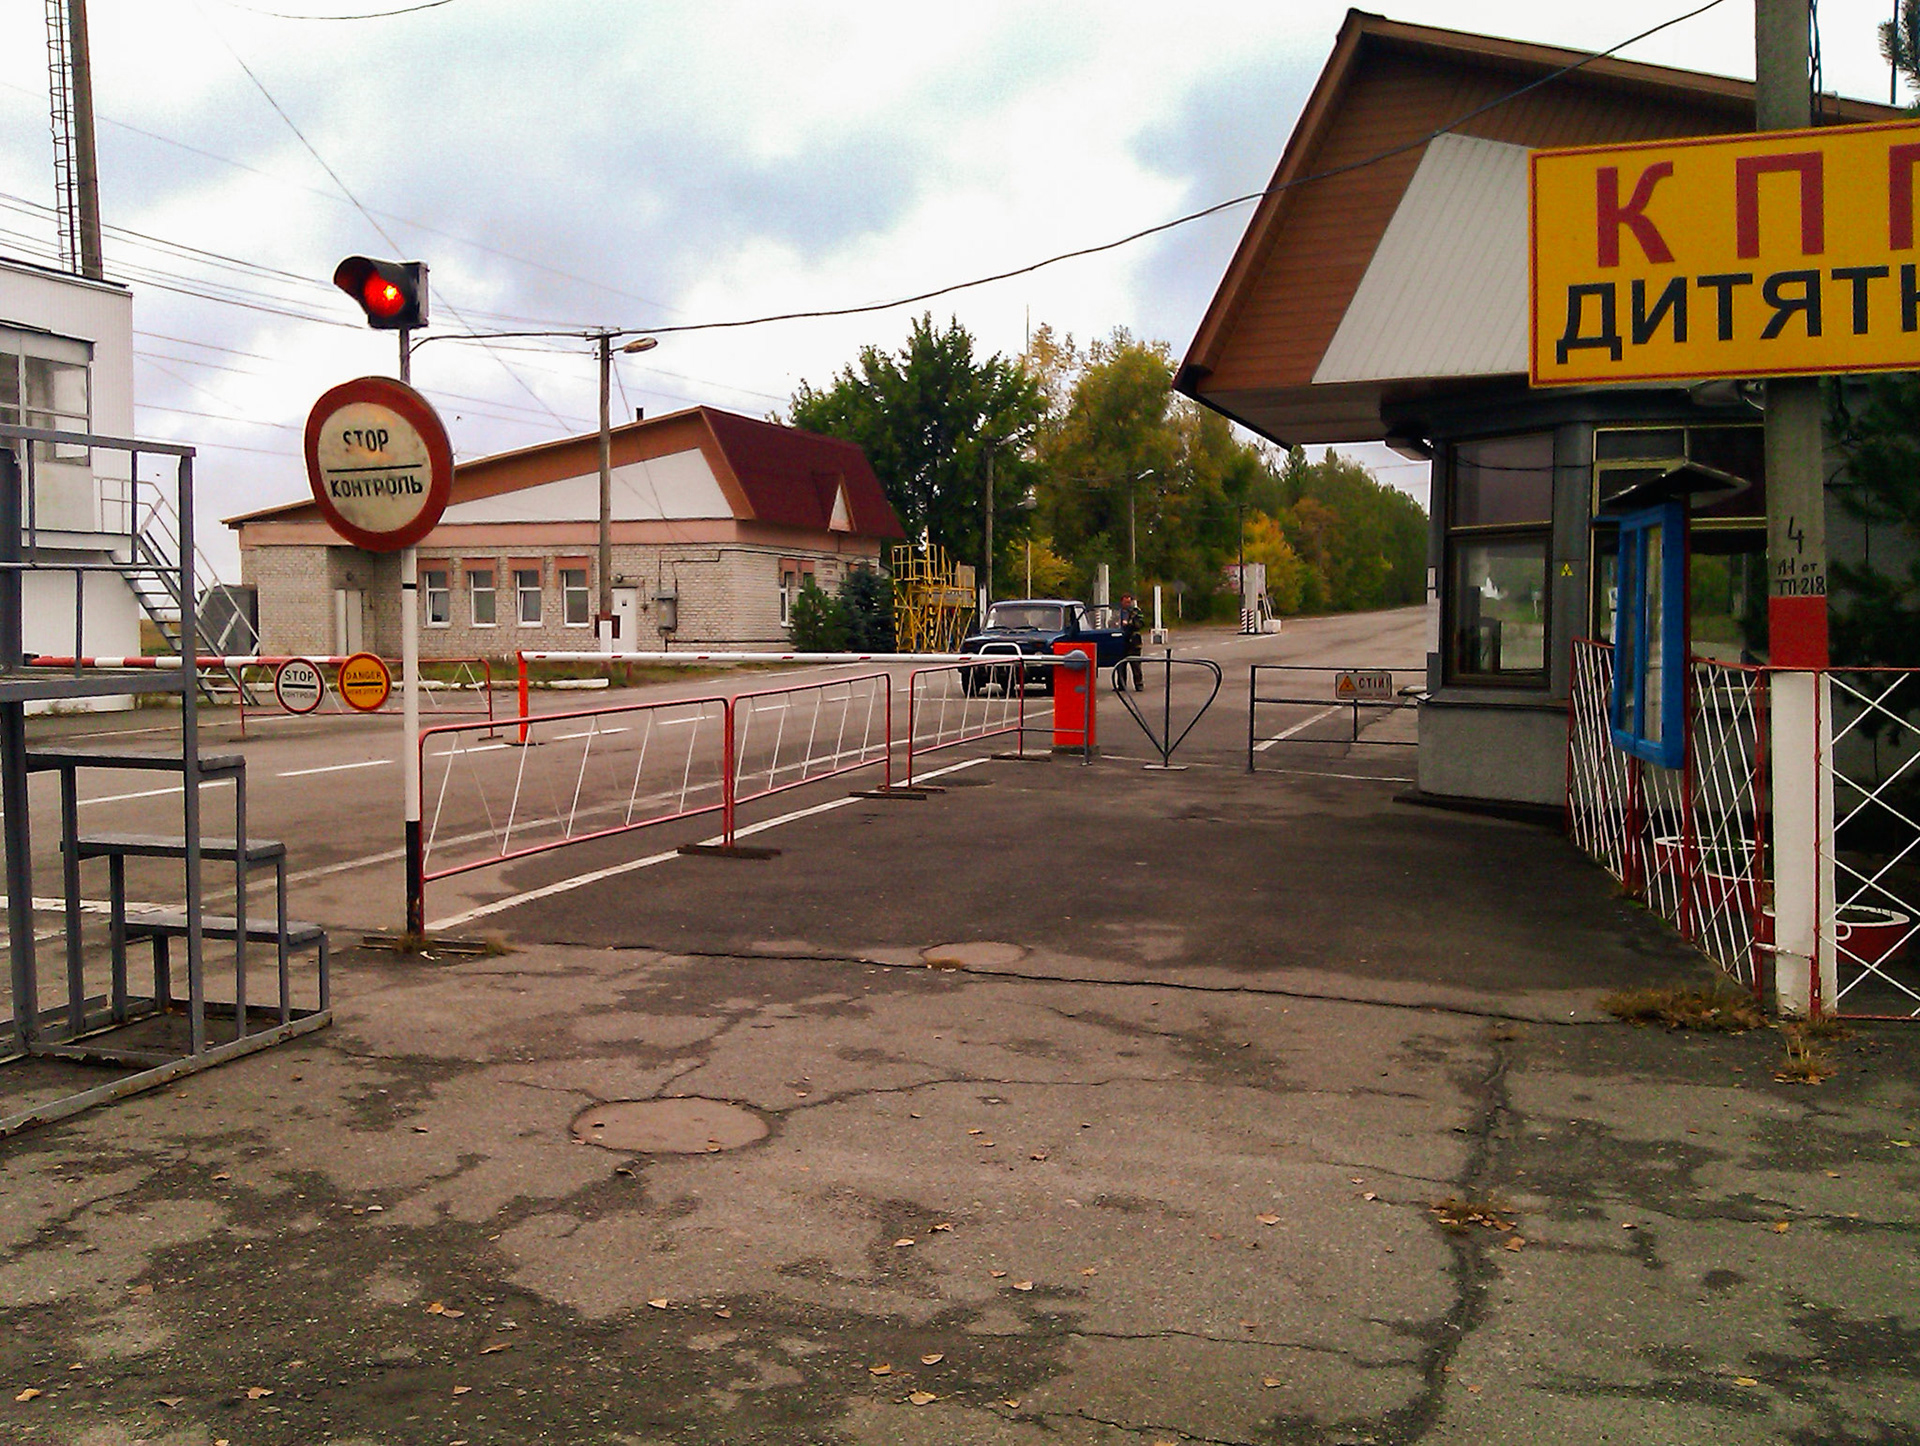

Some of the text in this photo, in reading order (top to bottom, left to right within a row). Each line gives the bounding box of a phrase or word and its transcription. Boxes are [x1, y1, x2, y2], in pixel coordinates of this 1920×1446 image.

[343, 429, 389, 453] STOP
[330, 475, 423, 498] КОНТРОЛЬ
[1787, 516, 1805, 554] 4
[284, 670, 315, 682] STOP
[345, 671, 383, 680] DANGER
